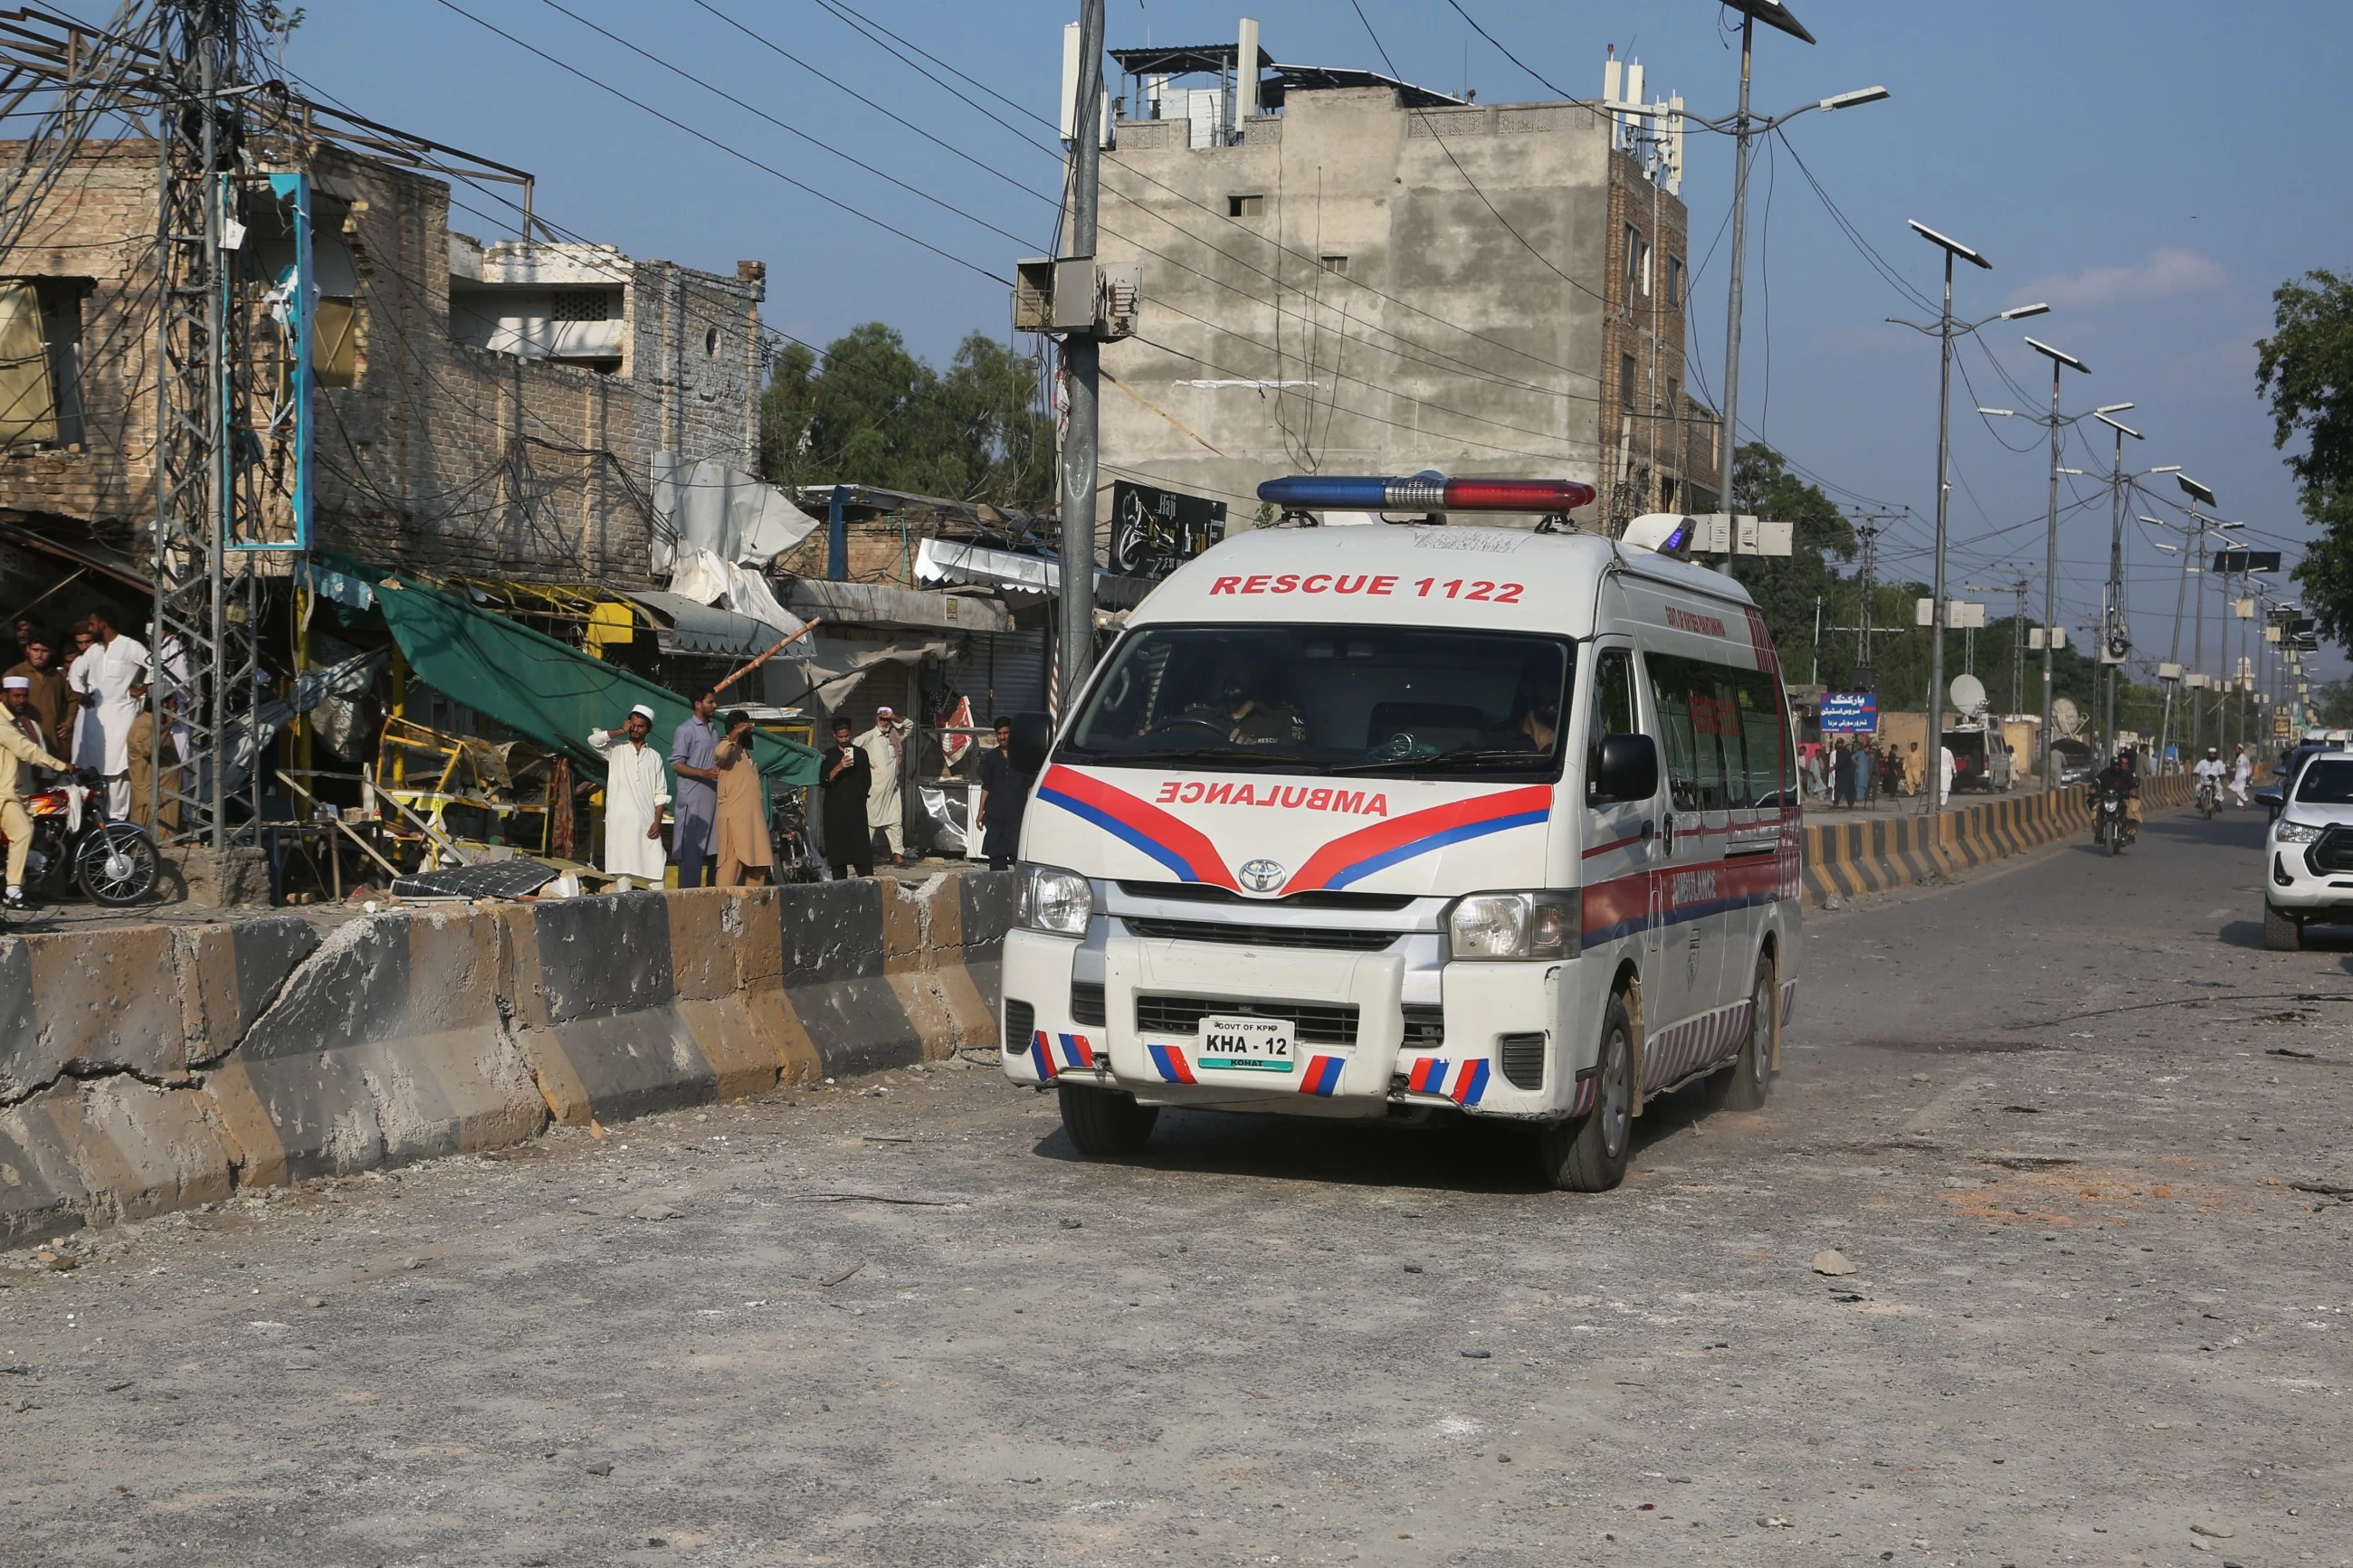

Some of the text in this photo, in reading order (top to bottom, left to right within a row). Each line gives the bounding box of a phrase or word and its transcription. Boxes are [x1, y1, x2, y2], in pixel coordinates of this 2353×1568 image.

[1158, 494, 1176, 520] Haji
[1209, 574, 1525, 604] RESCUE 1122
[1831, 694, 1865, 707] پارکنگ
[1672, 870, 1717, 904] AMBULANCE
[1218, 1022, 1241, 1031] GOVT
[1243, 1023, 1254, 1031] OF
[1206, 1034, 1247, 1053] KHA
[1265, 1037, 1287, 1055] 12
[1231, 1059, 1264, 1067] KOHAT
